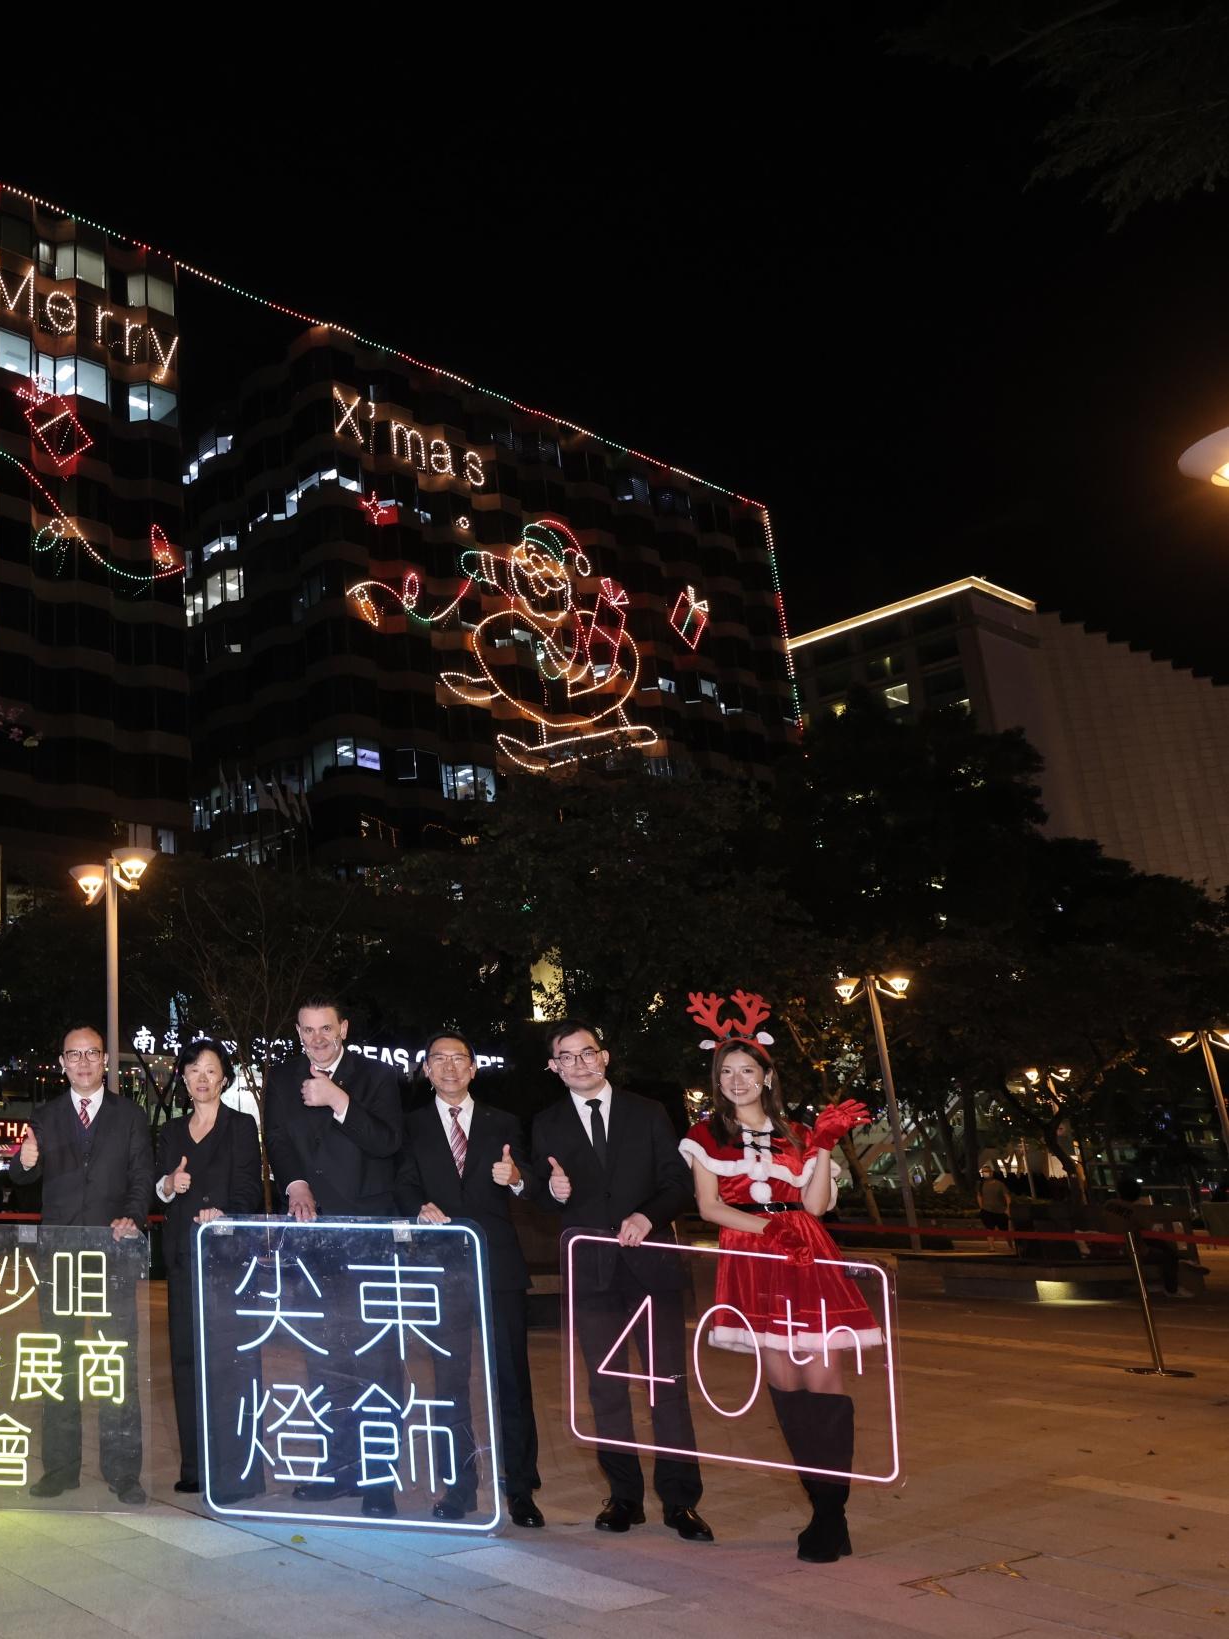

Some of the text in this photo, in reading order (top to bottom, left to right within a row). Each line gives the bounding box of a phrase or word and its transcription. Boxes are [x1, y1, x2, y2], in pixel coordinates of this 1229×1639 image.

[234, 1249, 452, 1361] 尖東
[596, 1294, 863, 1417] 40th
[237, 1378, 457, 1493] 燈飾
